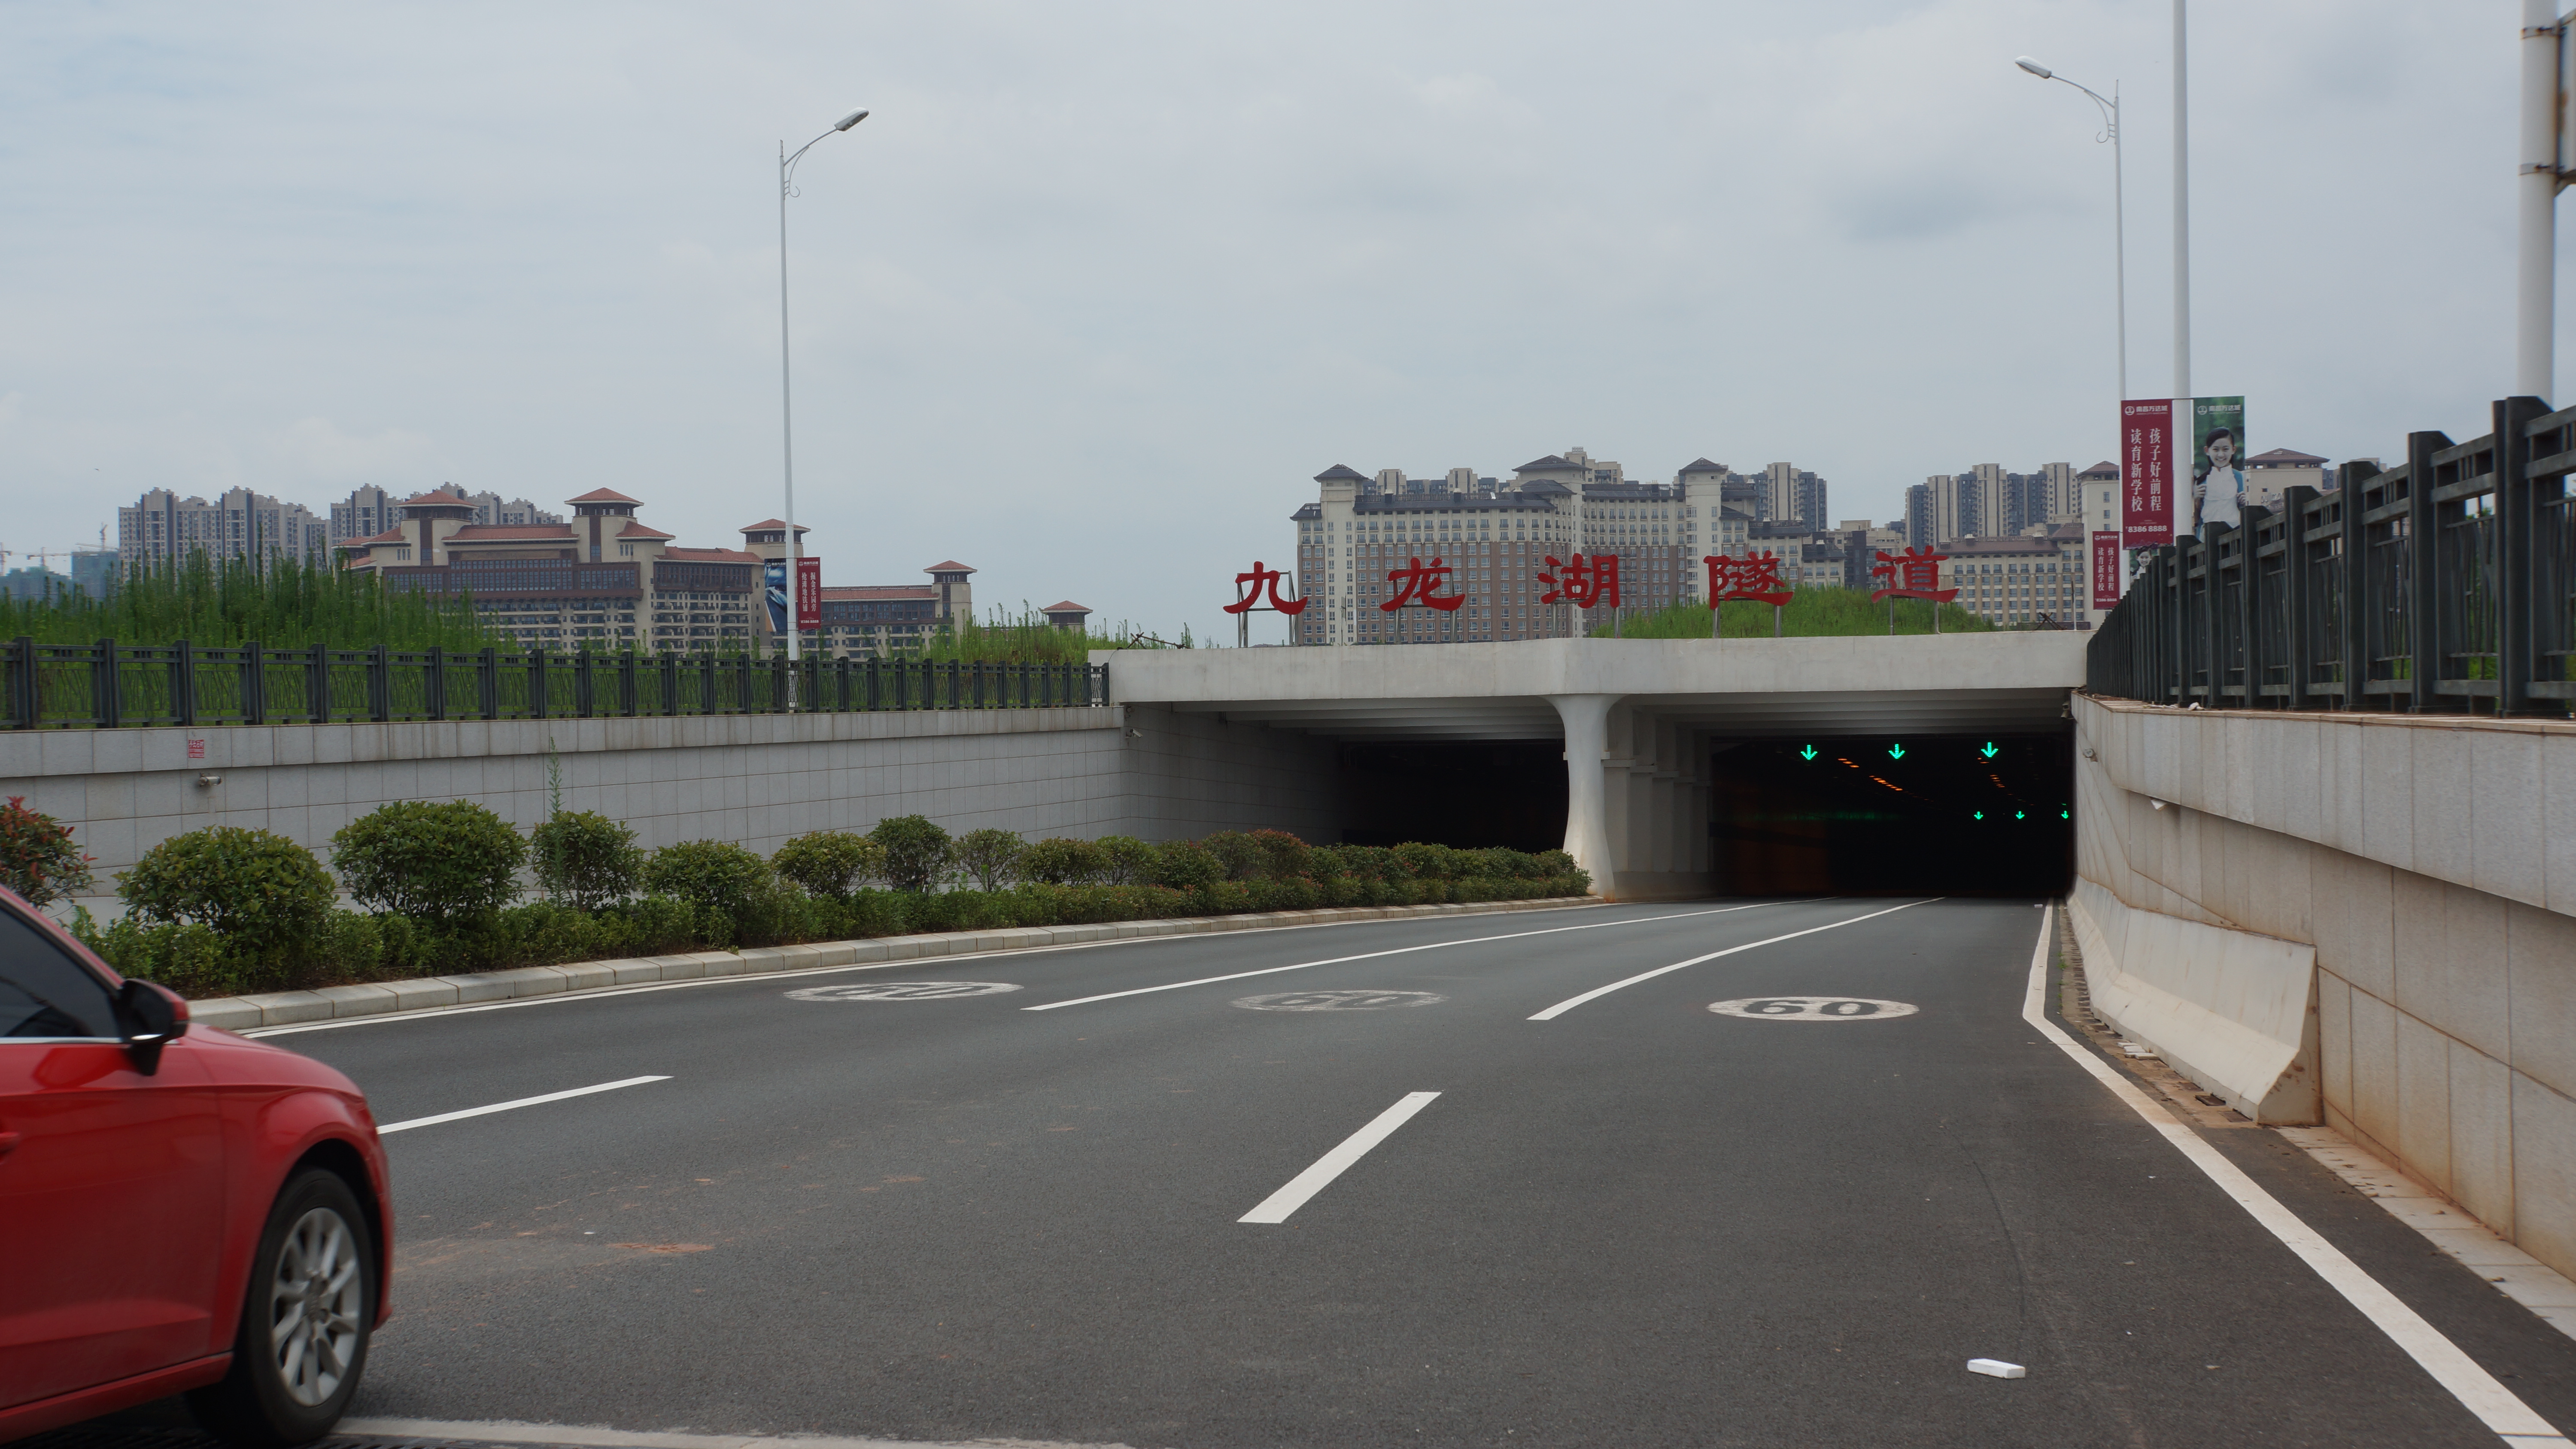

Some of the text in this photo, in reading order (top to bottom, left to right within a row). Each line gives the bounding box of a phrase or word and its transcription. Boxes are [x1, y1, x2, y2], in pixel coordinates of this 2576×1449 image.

[2130, 428, 2143, 512] 读育新学校
[2149, 427, 2162, 511] 孩子好前程
[1224, 546, 1959, 615] 九龙湖隧道
[1744, 1000, 1880, 1016] 60
